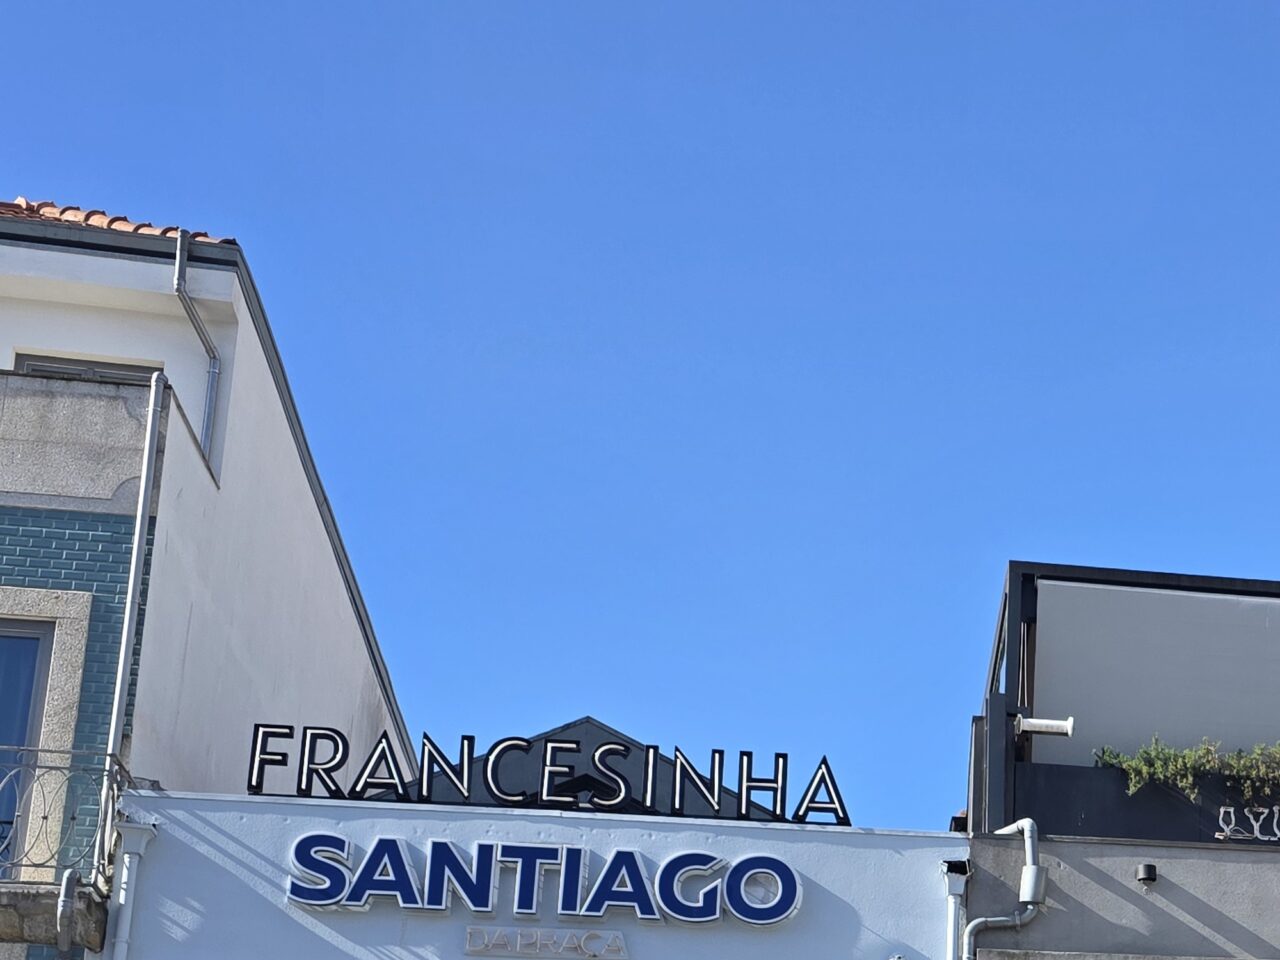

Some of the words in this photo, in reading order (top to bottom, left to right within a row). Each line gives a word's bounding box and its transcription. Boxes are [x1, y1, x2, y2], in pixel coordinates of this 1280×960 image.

[248, 723, 852, 826] FRANCESINHA
[286, 830, 803, 926] SANTIAGO
[466, 928, 511, 951] DA
